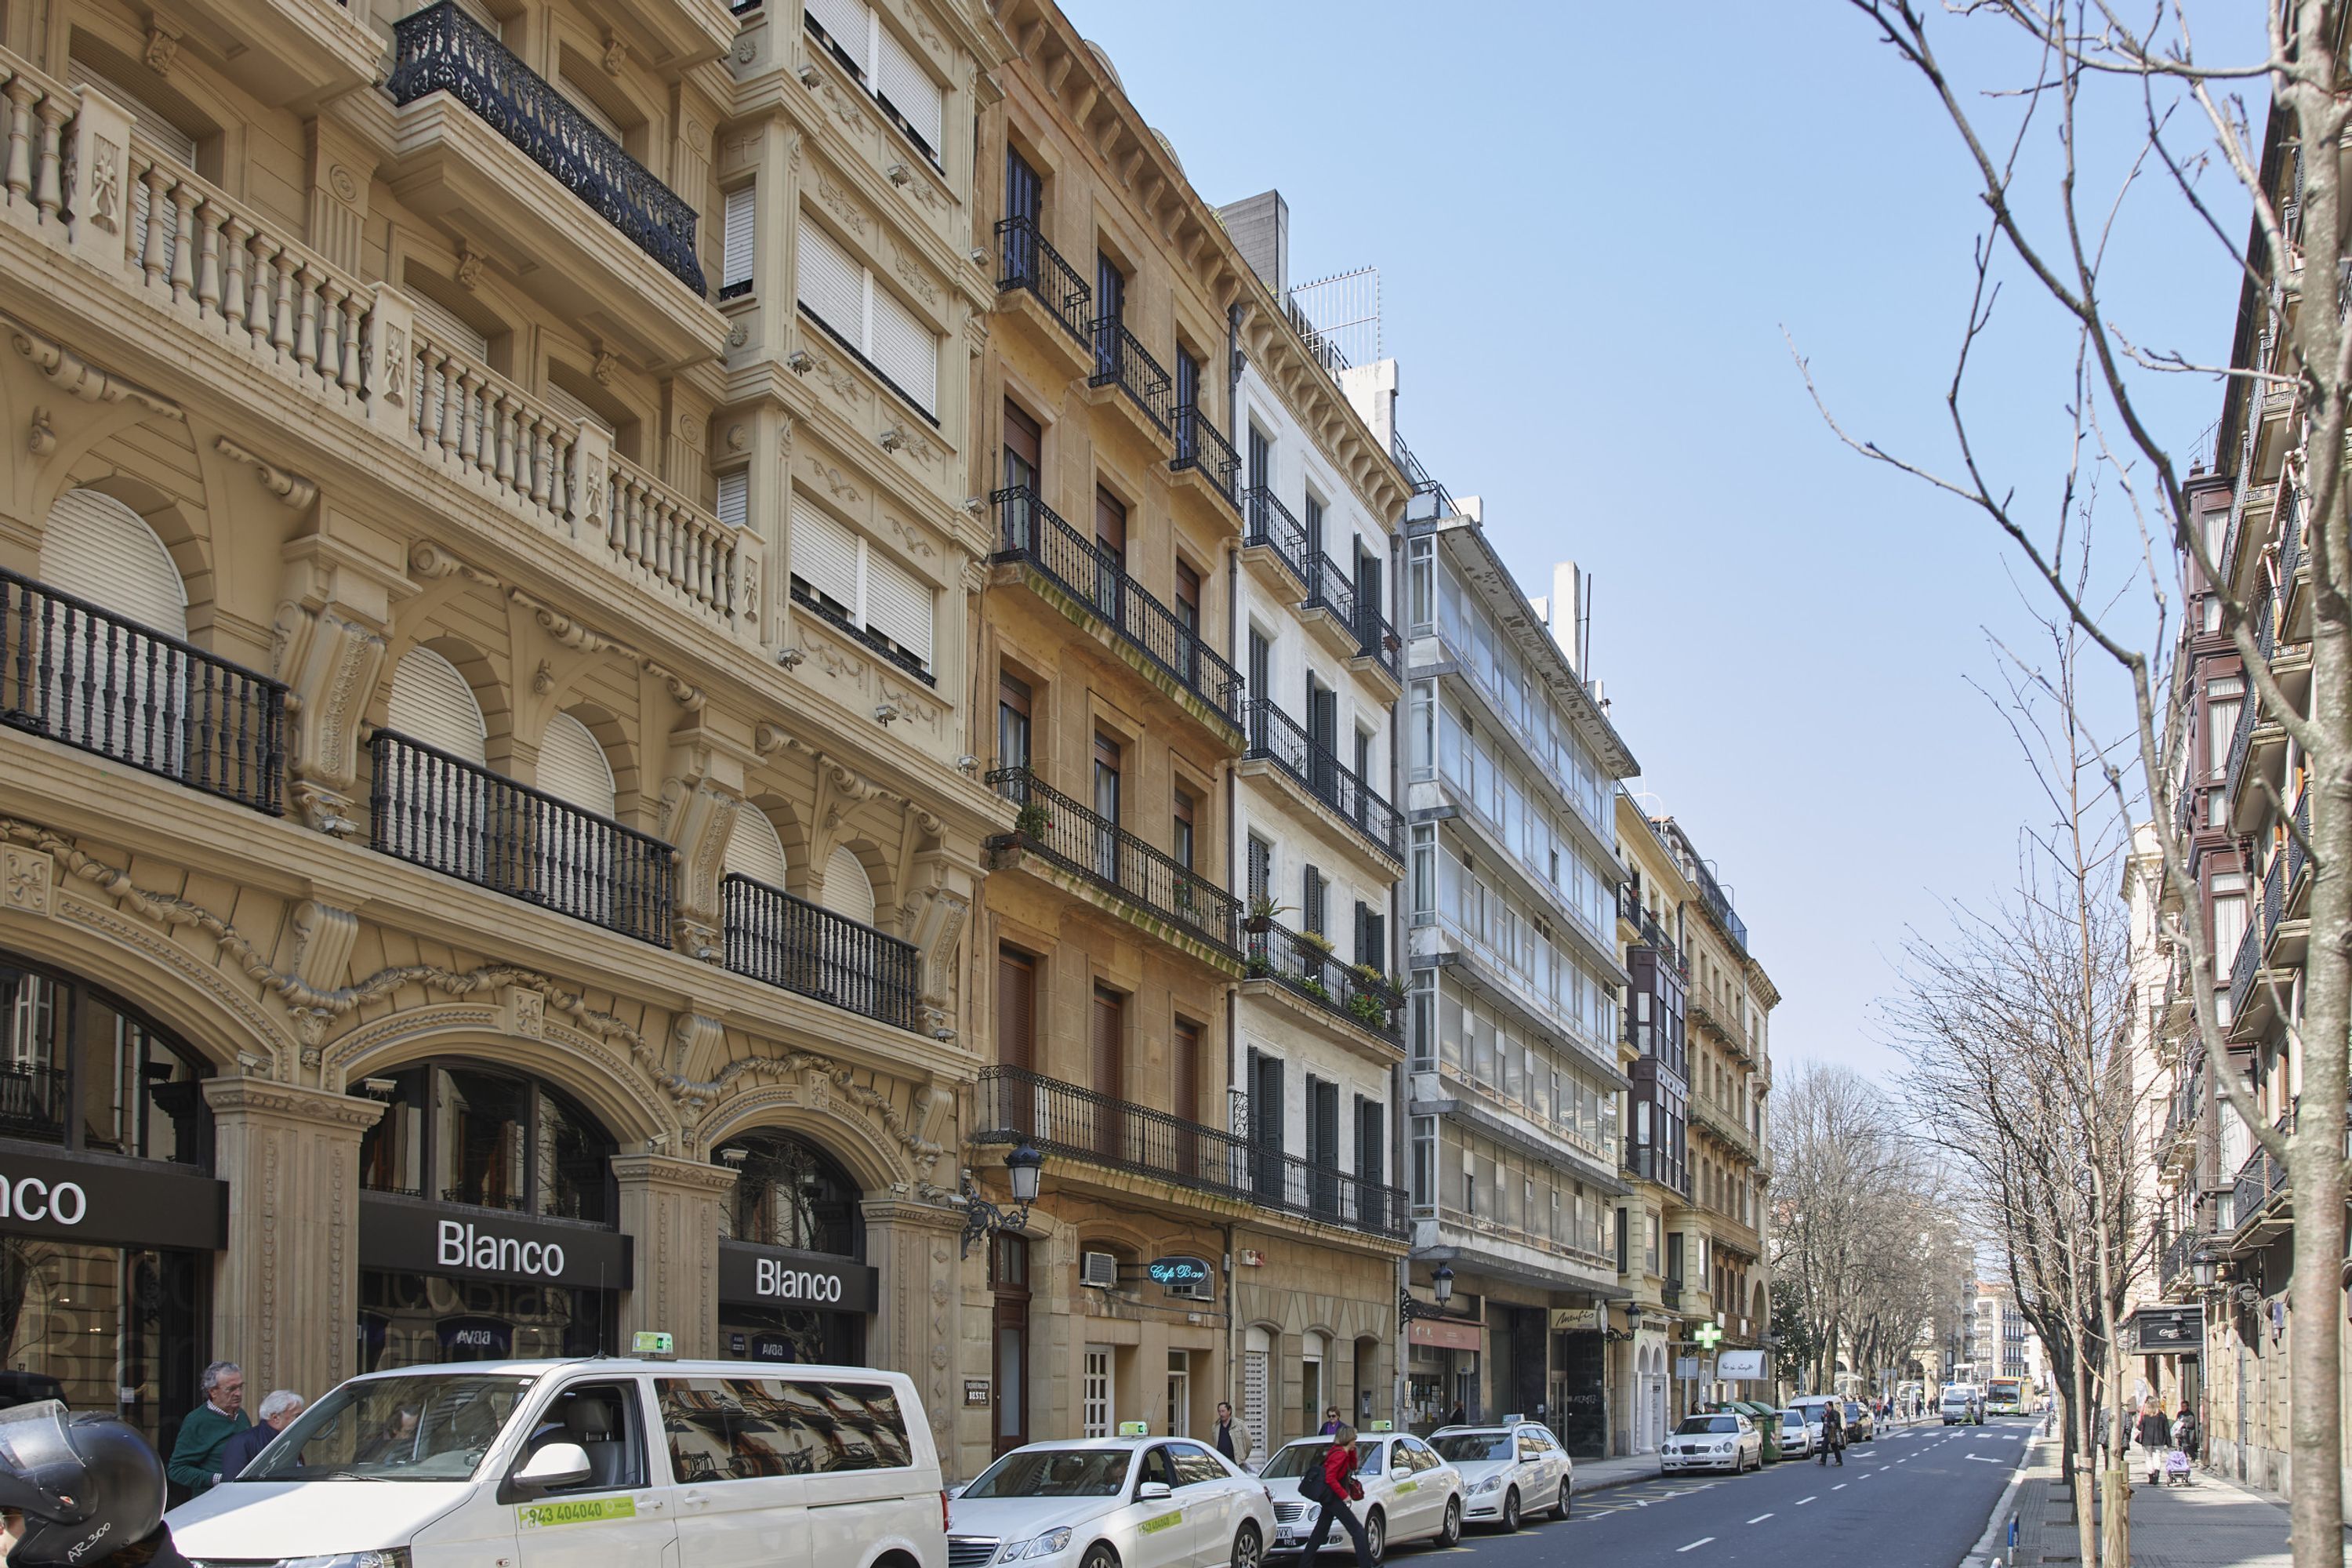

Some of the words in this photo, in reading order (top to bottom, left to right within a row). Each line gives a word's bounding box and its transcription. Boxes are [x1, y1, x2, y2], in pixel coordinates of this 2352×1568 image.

[437, 1220, 564, 1276] Blanco
[756, 1258, 841, 1302] Blanco
[1176, 1265, 1204, 1279] Bar
[529, 1507, 554, 1523] 943
[557, 1502, 602, 1521] 404040
